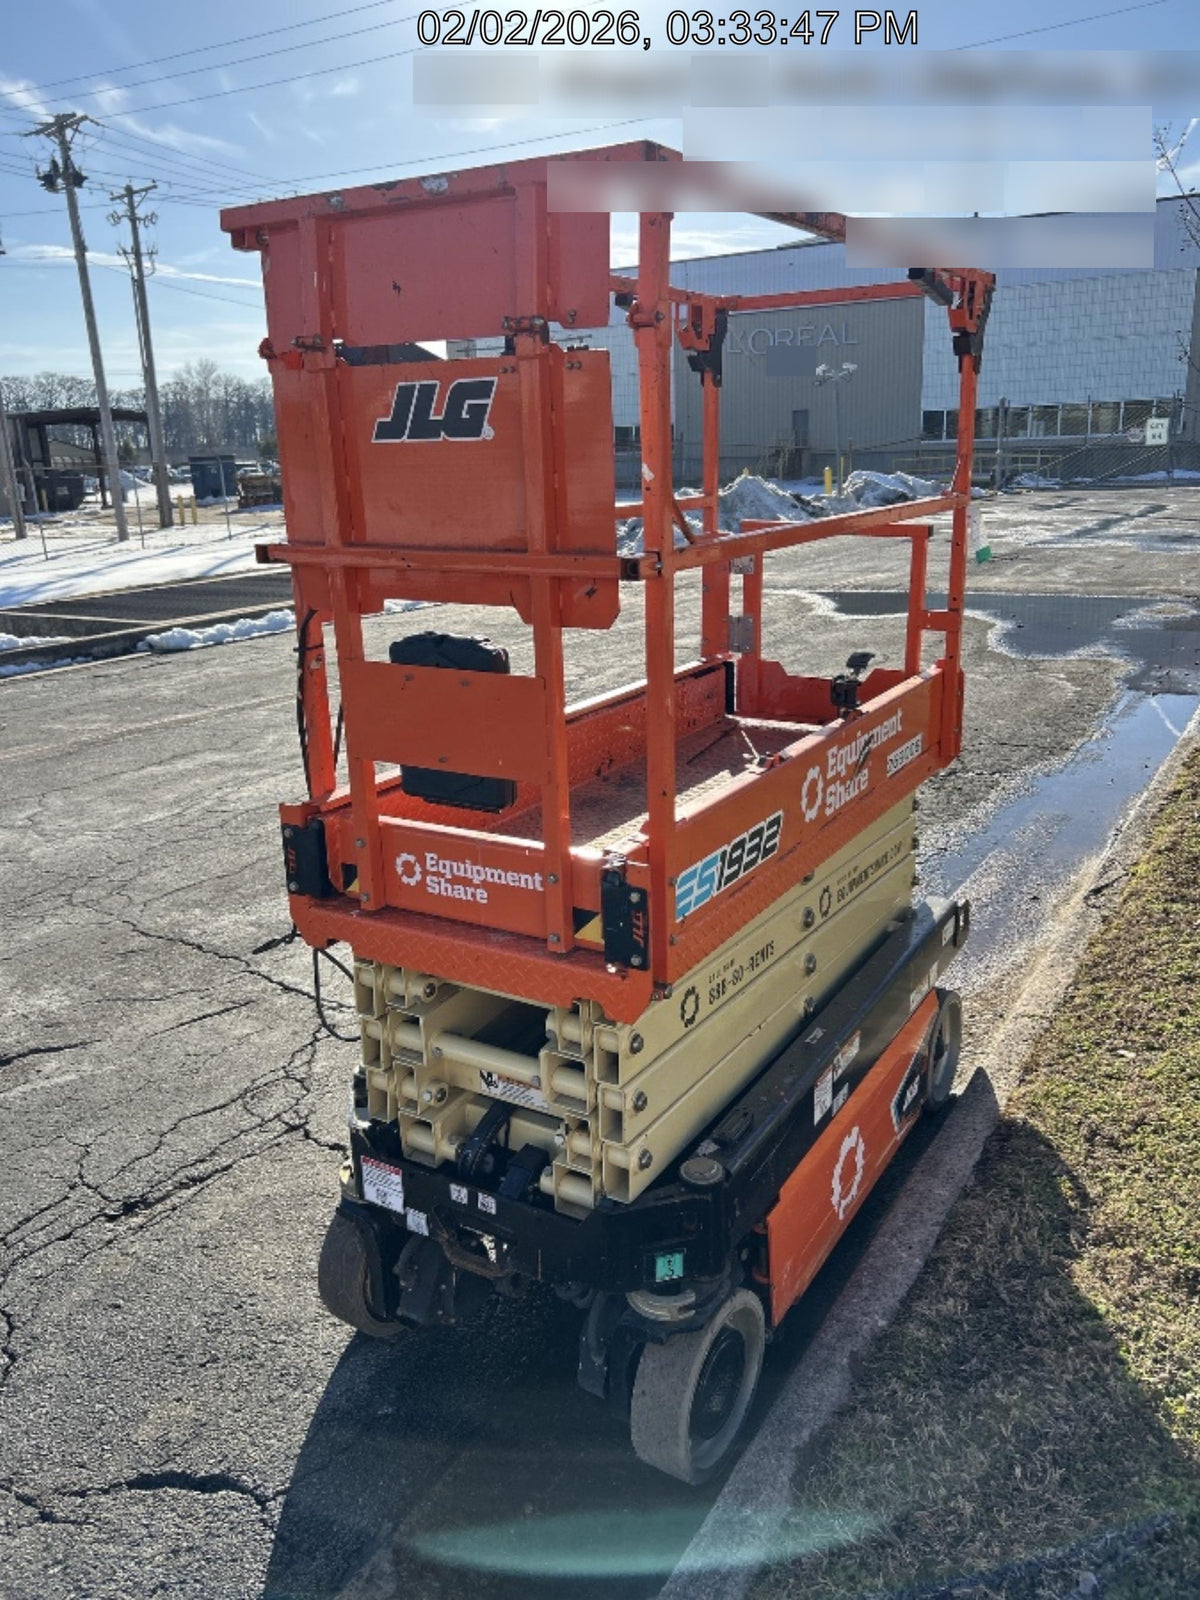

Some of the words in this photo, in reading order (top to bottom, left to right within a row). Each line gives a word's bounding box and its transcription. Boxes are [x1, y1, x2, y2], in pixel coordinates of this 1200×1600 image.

[371, 376, 498, 443] JLG
[824, 768, 869, 817] Share
[424, 852, 544, 892] Equipment
[425, 874, 488, 904] Share
[675, 809, 784, 924] ES1932
